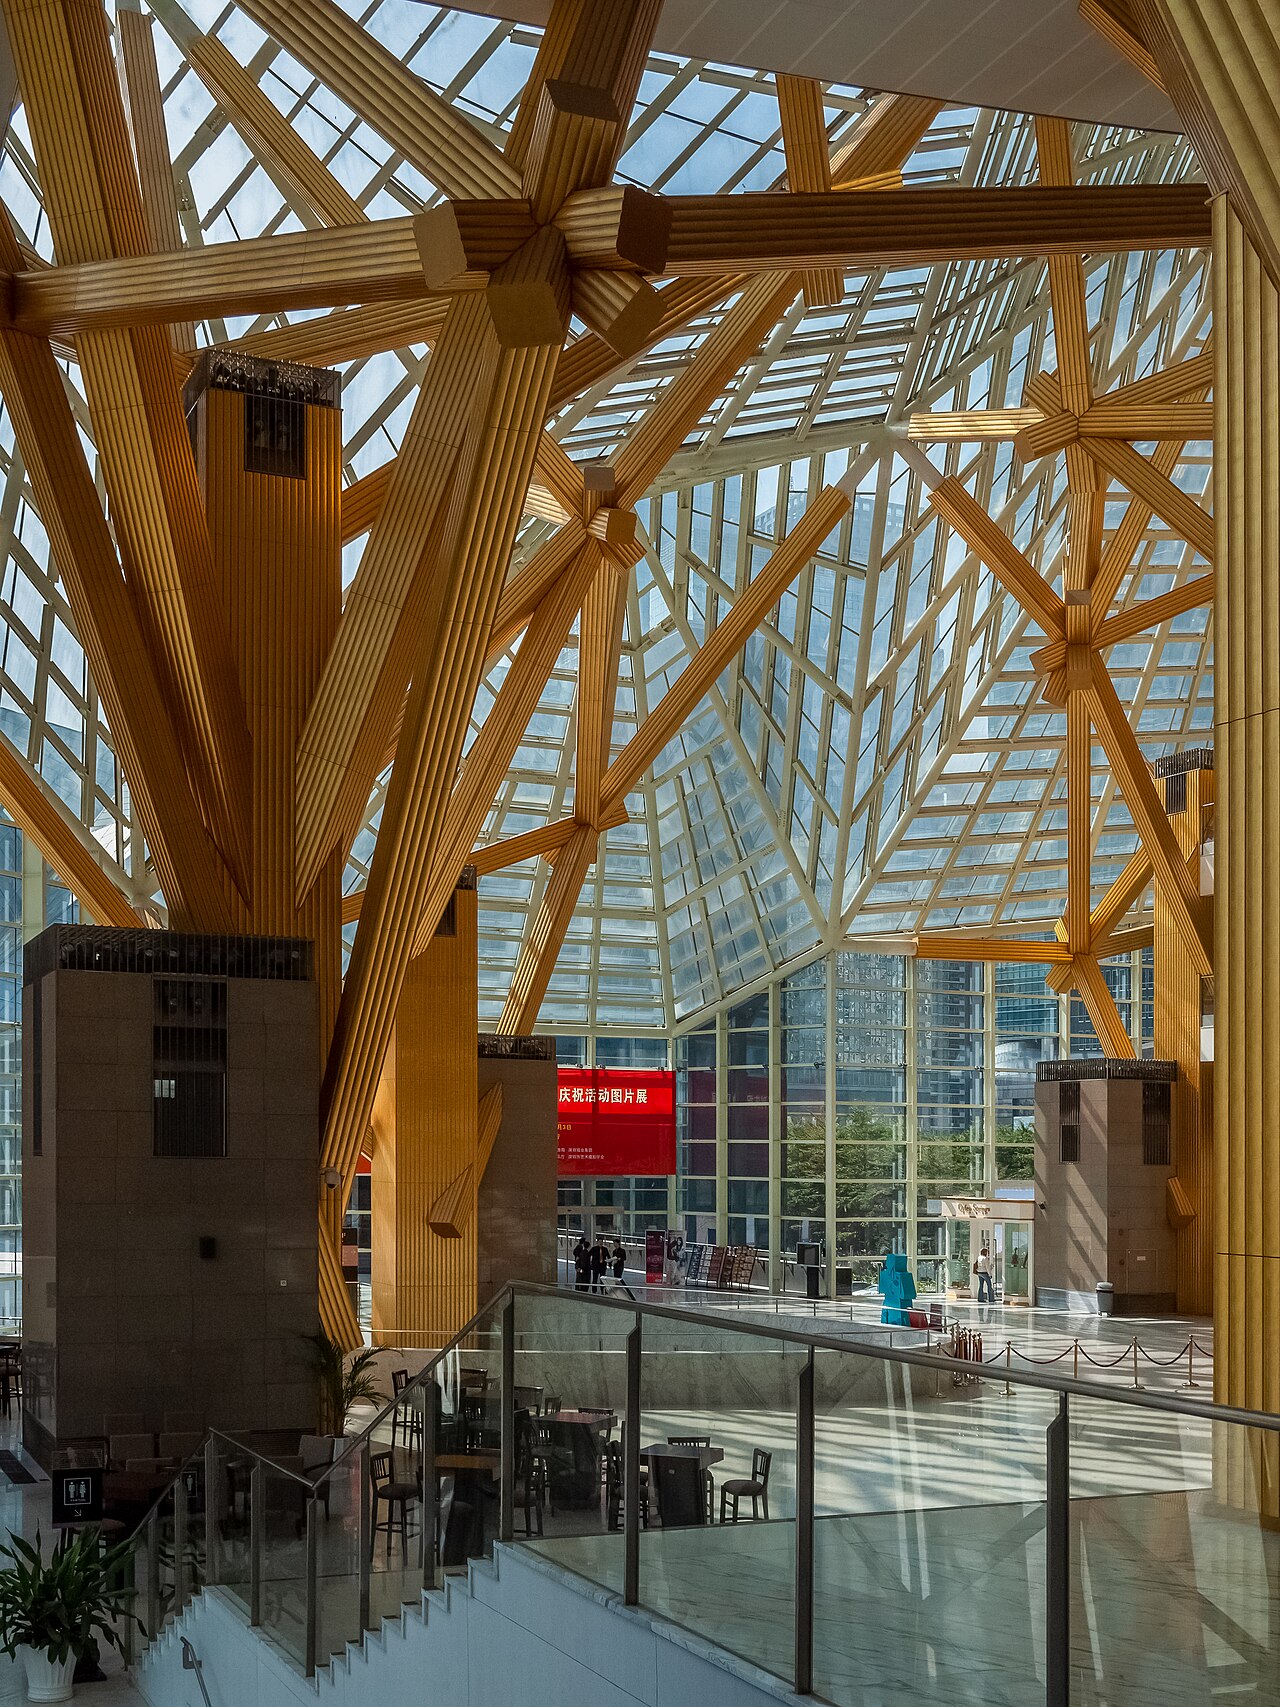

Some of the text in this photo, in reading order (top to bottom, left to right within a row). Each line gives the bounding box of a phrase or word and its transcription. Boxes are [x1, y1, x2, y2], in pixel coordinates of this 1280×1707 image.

[559, 1087, 648, 1104] 庆祝活动图片展
